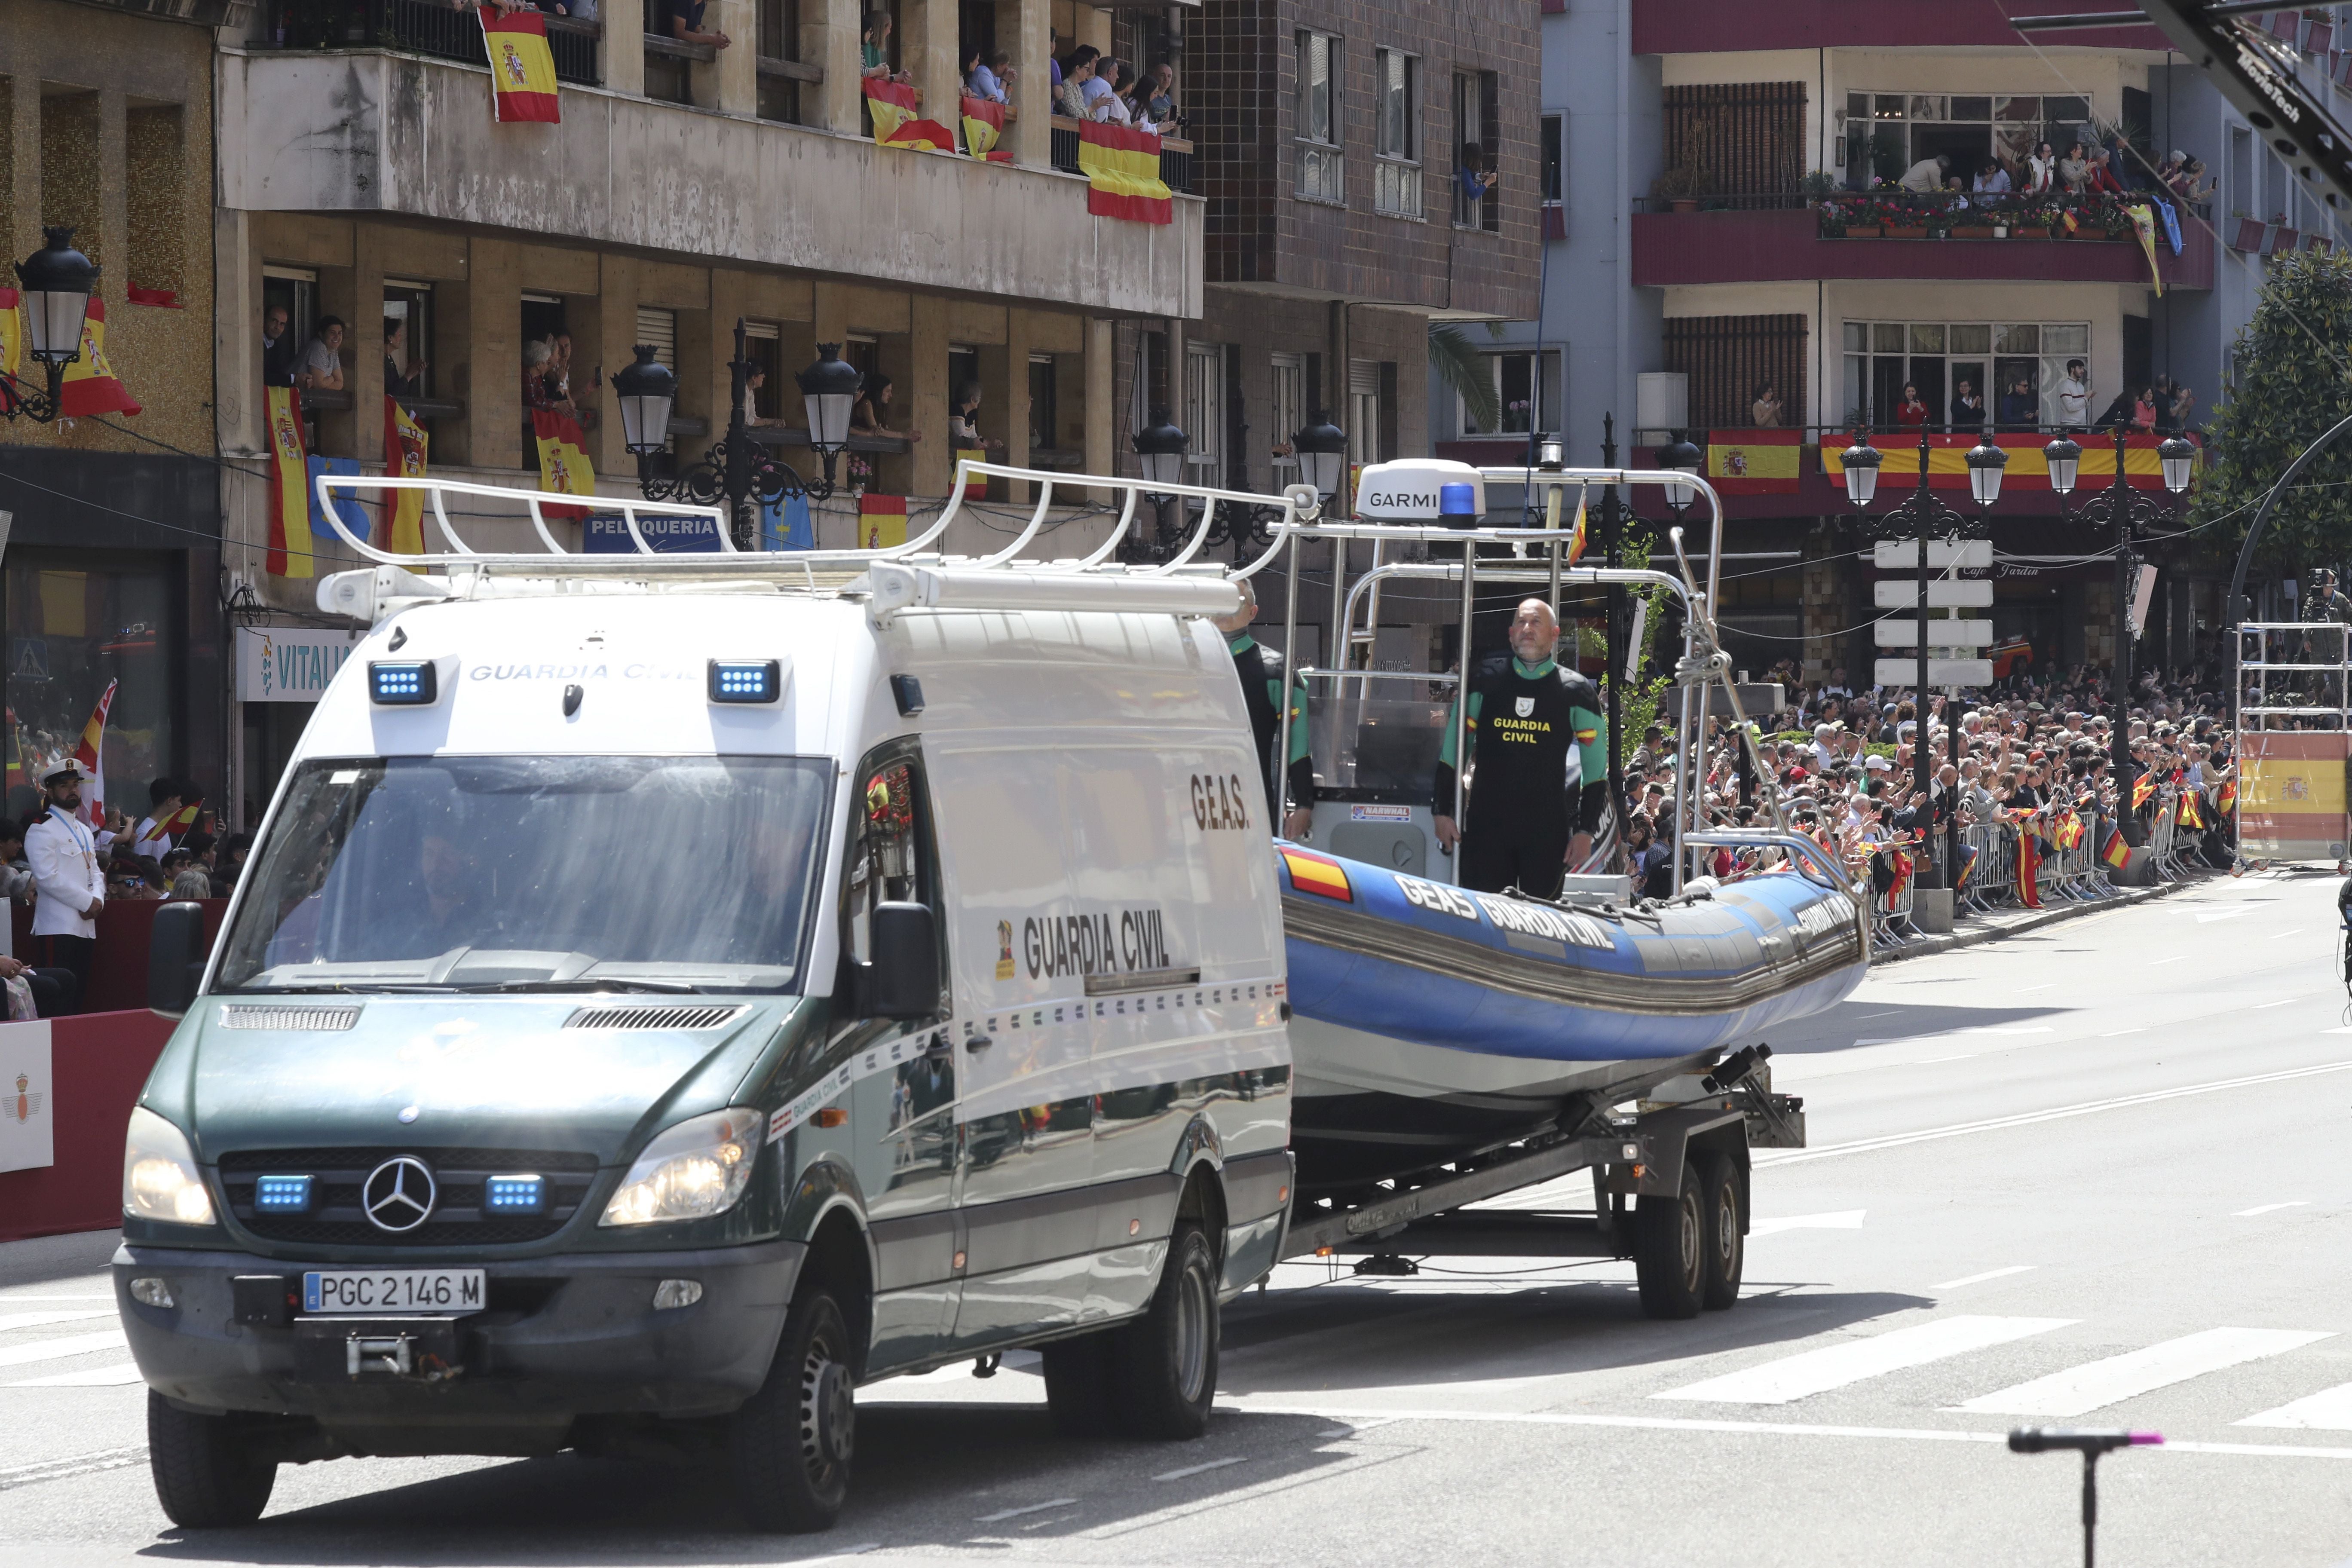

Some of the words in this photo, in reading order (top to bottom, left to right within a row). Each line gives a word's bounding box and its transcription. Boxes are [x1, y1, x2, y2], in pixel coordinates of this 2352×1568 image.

[2237, 52, 2300, 123] MovieTech
[1370, 493, 1437, 508] GARMI
[469, 664, 608, 681] GUARDIA
[623, 663, 698, 680] CIVIL
[1494, 717, 1551, 732] GUARDIA
[1502, 731, 1537, 744] CIVIL
[1191, 774, 1250, 830] G.E.A.S.
[1365, 807, 1408, 816] NARWHAL
[1394, 875, 1478, 920] GEAS
[1476, 896, 1576, 943] GUARDIA
[1560, 914, 1615, 949] CIVIL
[1797, 903, 1834, 936] GUARDIA
[1024, 917, 1117, 980] GUARDIA
[1121, 909, 1169, 971] CIVIL
[793, 1089, 823, 1118] GUARDIA
[322, 1277, 374, 1306] PGC
[381, 1276, 451, 1305] 2146
[462, 1275, 478, 1304] M
